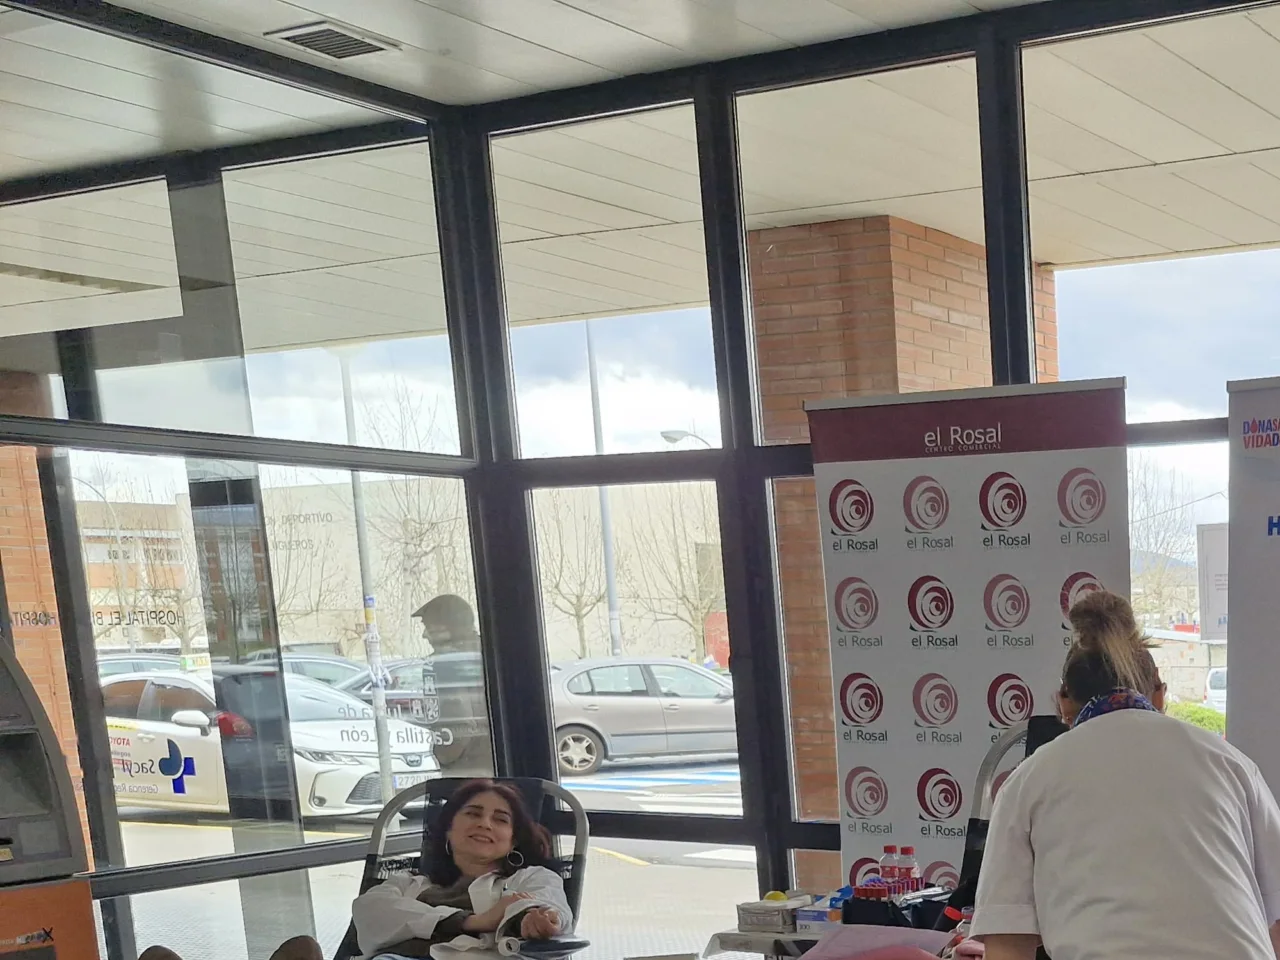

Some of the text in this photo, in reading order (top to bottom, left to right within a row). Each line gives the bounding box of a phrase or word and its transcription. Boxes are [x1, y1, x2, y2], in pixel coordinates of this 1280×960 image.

[924, 421, 1001, 447] el Rosal
[925, 443, 1001, 453] CENTRO COMERCIAL
[907, 536, 954, 549] el Rosal
[983, 533, 1031, 546] el Rosal
[1060, 529, 1110, 544] el Rosal
[832, 538, 878, 551] el Rosal
[838, 635, 883, 647] el Rosal
[912, 635, 958, 647] el Rosal
[987, 634, 1034, 647] el Rosal
[843, 730, 888, 742] el Rosal
[916, 731, 962, 743] el Rosal
[848, 822, 892, 834] el Rosal
[920, 825, 966, 837] el Rosal
